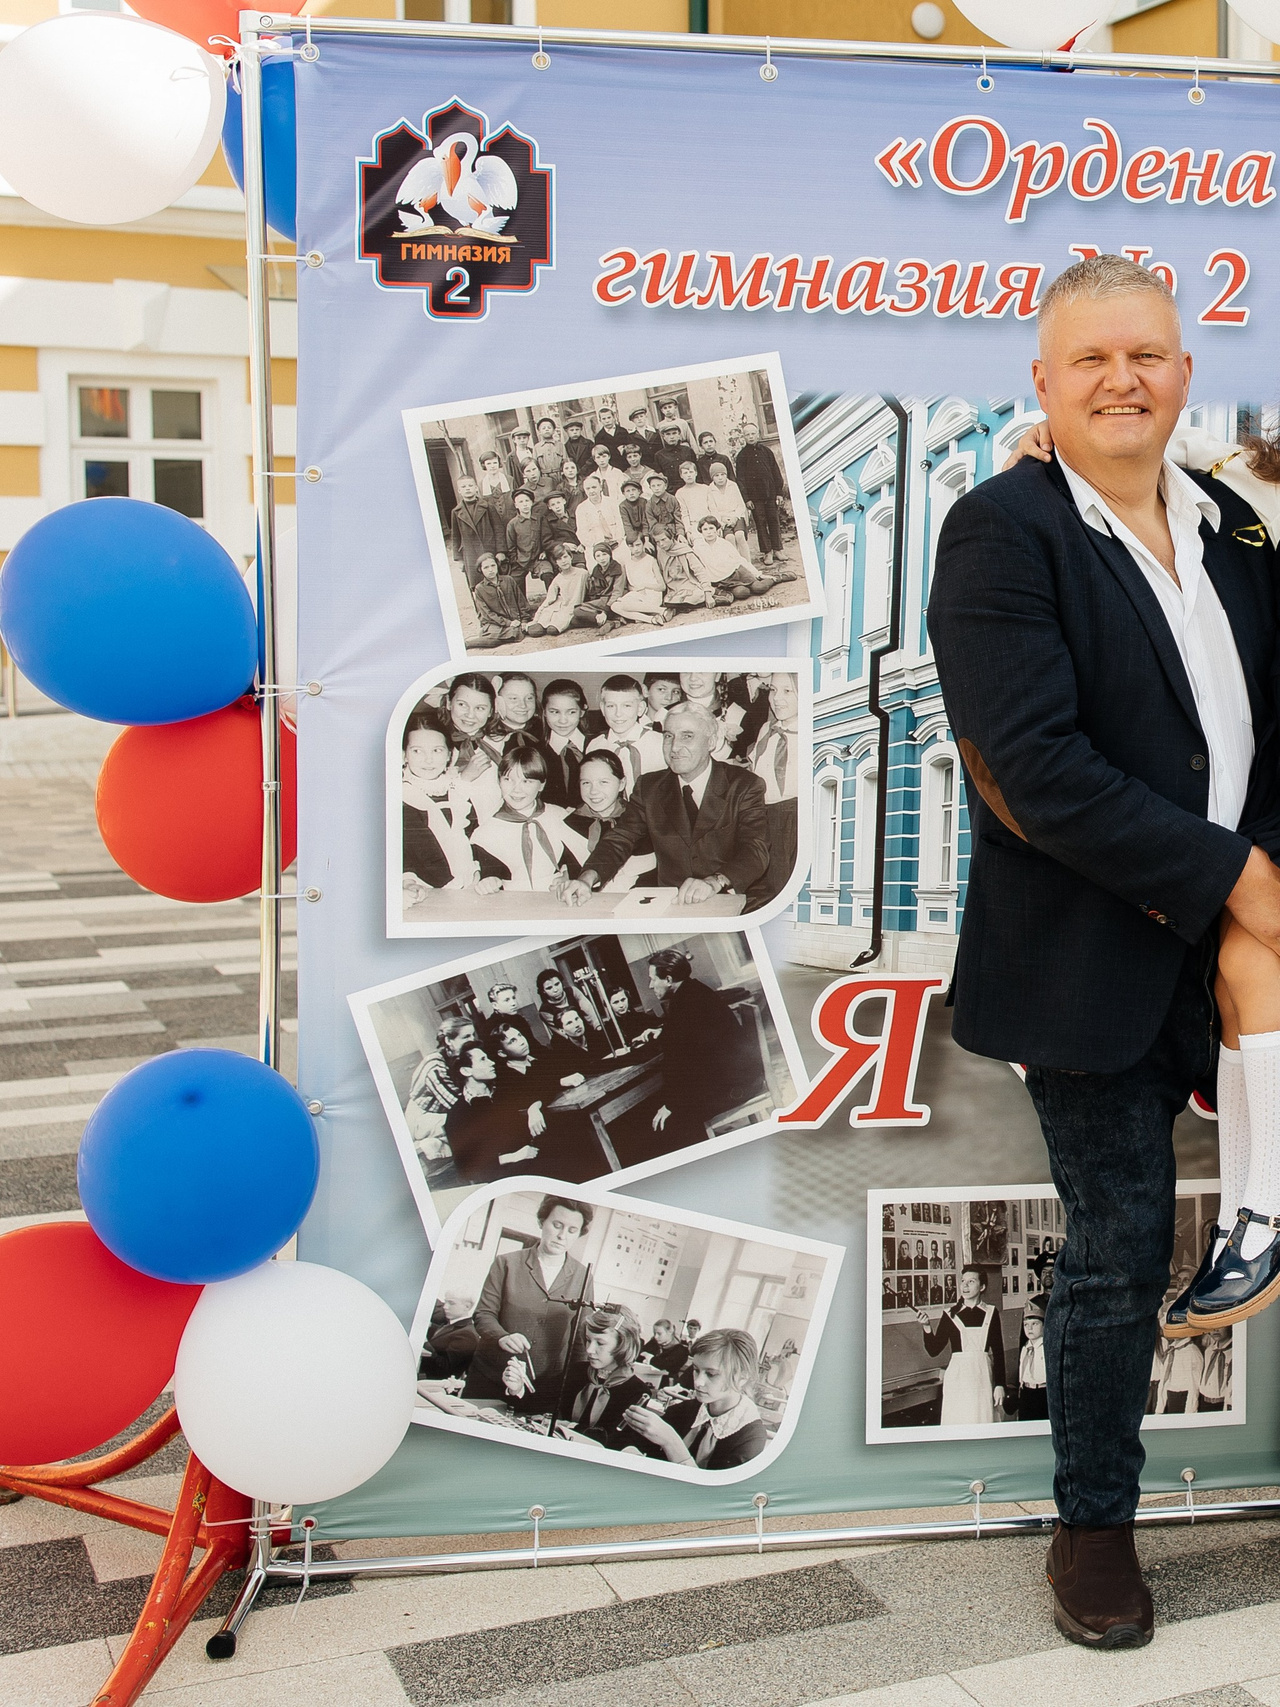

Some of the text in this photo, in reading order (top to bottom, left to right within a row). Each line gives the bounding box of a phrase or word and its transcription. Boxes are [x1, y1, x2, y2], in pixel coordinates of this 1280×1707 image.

[877, 116, 1274, 222] «Ордена
[401, 243, 511, 264] ГИМНАЗИЯ
[444, 266, 471, 305] 2
[594, 248, 1043, 318] гимназия
[1200, 250, 1247, 324] 2
[776, 977, 946, 1125] Я
